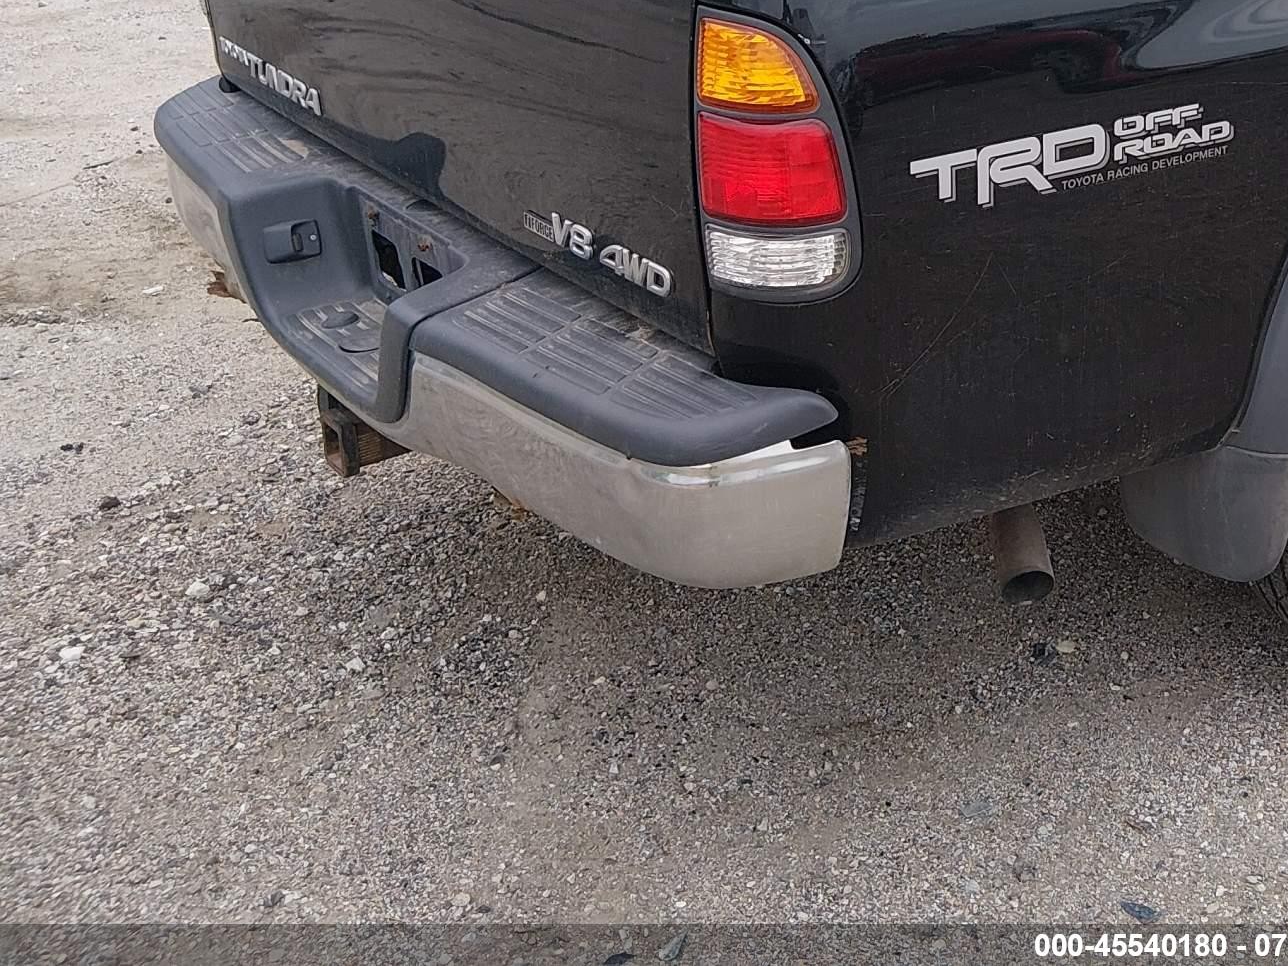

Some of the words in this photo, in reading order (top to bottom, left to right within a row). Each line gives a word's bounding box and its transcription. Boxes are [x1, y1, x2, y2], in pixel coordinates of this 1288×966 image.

[246, 52, 322, 116] TUNDRA
[1113, 103, 1204, 140] OFF
[1113, 120, 1234, 164] ROAD
[909, 123, 1111, 208] TRD
[1061, 173, 1105, 191] TOYOTA
[1106, 162, 1149, 181] RACING
[1151, 145, 1229, 171] DEVELOPMENT
[551, 211, 595, 260] V8
[599, 244, 672, 297] 4WD
